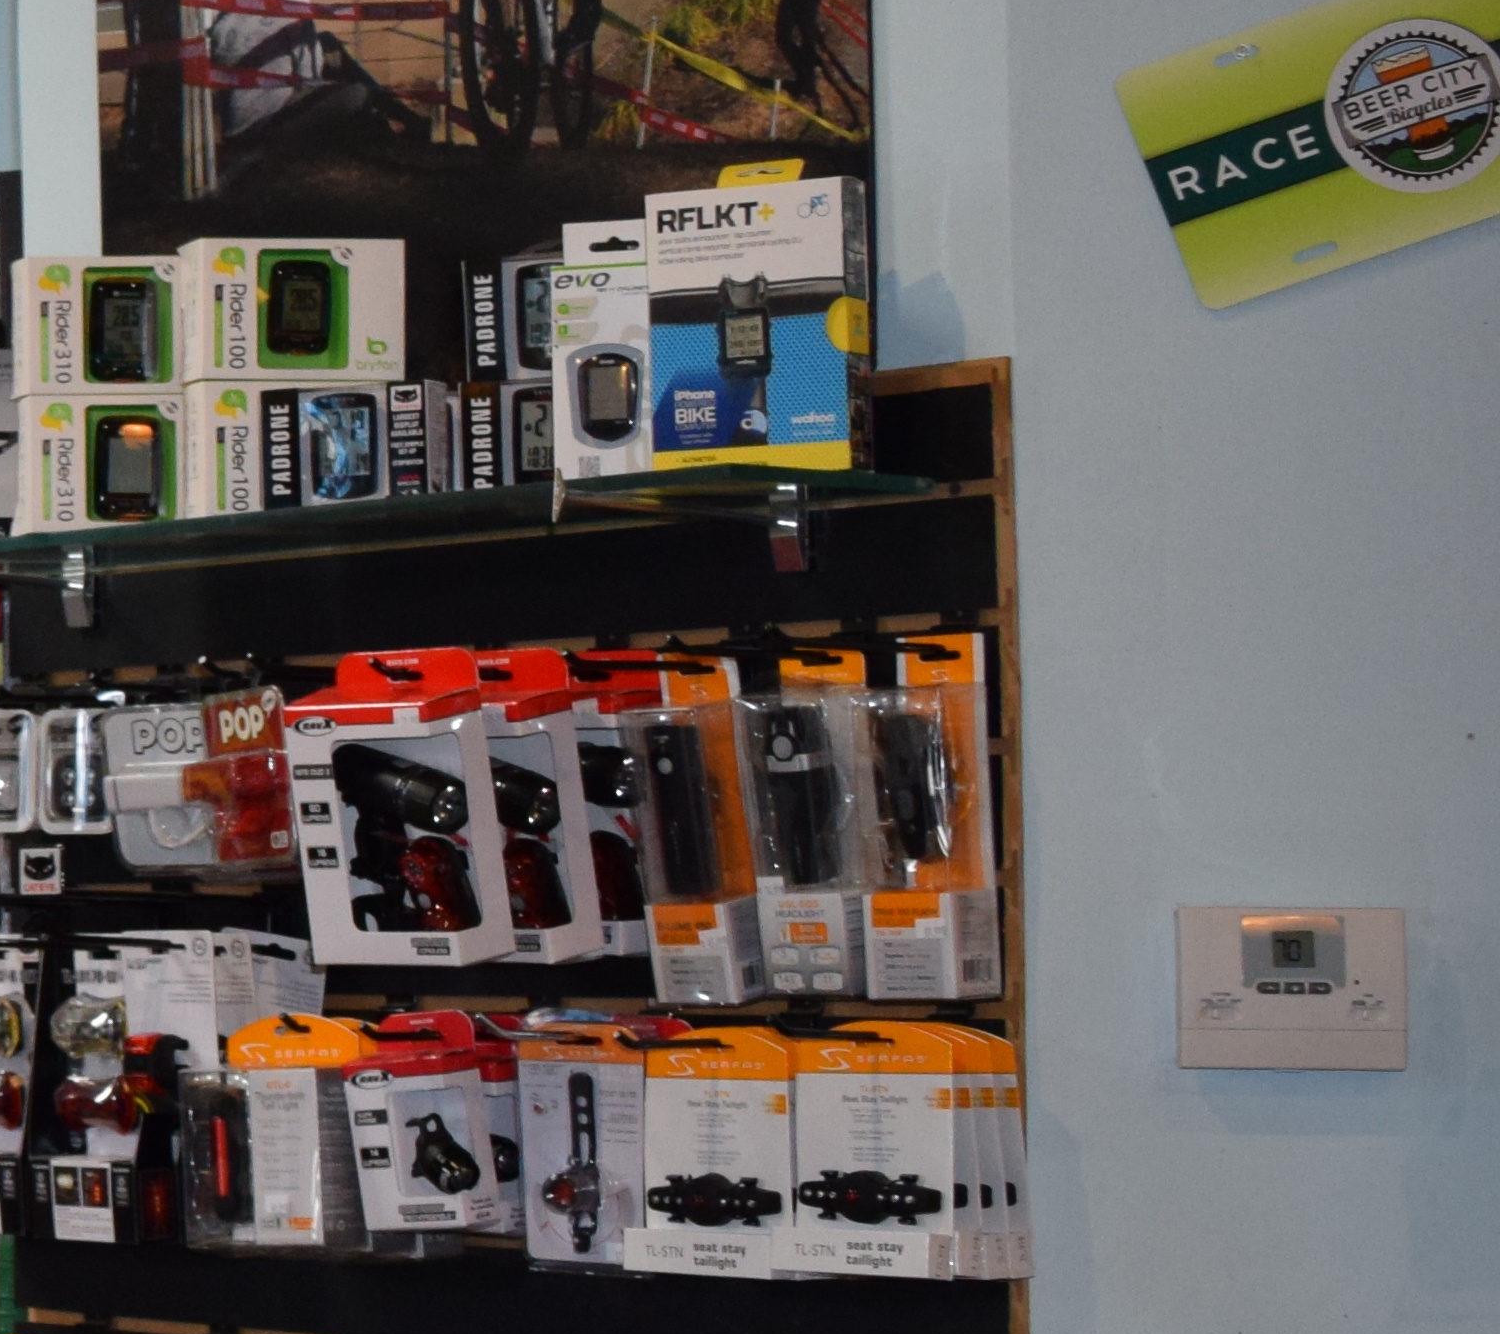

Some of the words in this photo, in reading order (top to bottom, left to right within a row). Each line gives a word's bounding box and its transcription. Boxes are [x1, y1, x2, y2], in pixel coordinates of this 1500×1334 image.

[1344, 84, 1412, 121] BEER
[1420, 62, 1481, 94] CITY
[1387, 94, 1454, 126] Bicycles
[1167, 124, 1321, 202] RACE
[656, 199, 776, 234] RFLKT+
[554, 272, 611, 290] evo
[56, 300, 72, 344] Rider
[230, 284, 247, 333] Rider
[473, 272, 495, 367] PADRONE
[56, 347, 71, 384] 310
[230, 337, 247, 369] 100
[673, 405, 718, 426] BIKE
[231, 426, 248, 473] Rider
[271, 402, 291, 497] PADRONE
[471, 394, 493, 489] PADRONE
[56, 438, 74, 485] Rider
[57, 489, 74, 523] 310
[231, 476, 248, 512] 100
[218, 709, 264, 744] POP
[1275, 938, 1303, 962] 70
[273, 1048, 342, 1060] SERFAS
[700, 1060, 765, 1072] SERFAS
[856, 1054, 929, 1065] SERFAS
[645, 1243, 684, 1258] TL-STN
[693, 1241, 718, 1255] seat
[721, 1243, 746, 1257] stay
[693, 1254, 739, 1270] taillight
[794, 1243, 836, 1257] TL-STN
[846, 1239, 873, 1253] seat
[876, 1242, 904, 1256] stay
[846, 1252, 893, 1268] taillight
